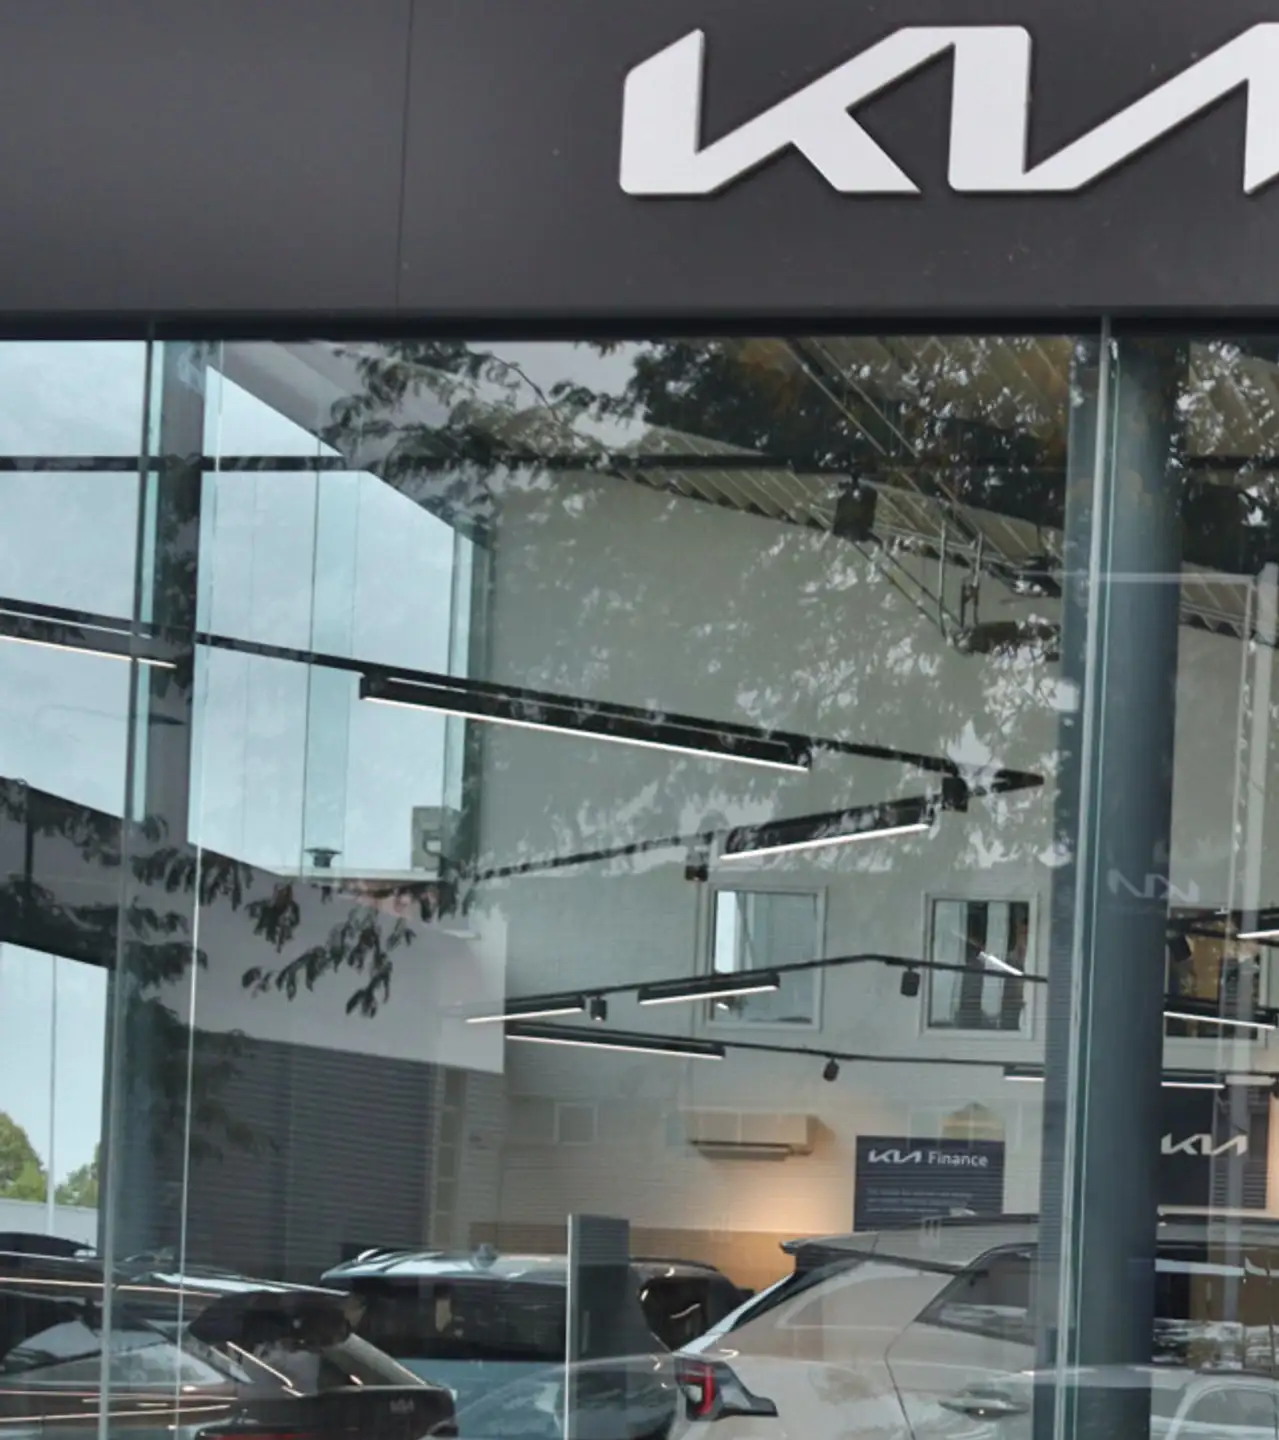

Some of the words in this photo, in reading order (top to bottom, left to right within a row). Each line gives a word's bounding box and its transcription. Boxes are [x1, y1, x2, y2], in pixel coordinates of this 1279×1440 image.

[1160, 1132, 1249, 1156] KIA
[867, 1149, 922, 1164] KIA
[927, 1151, 989, 1168] Finance
